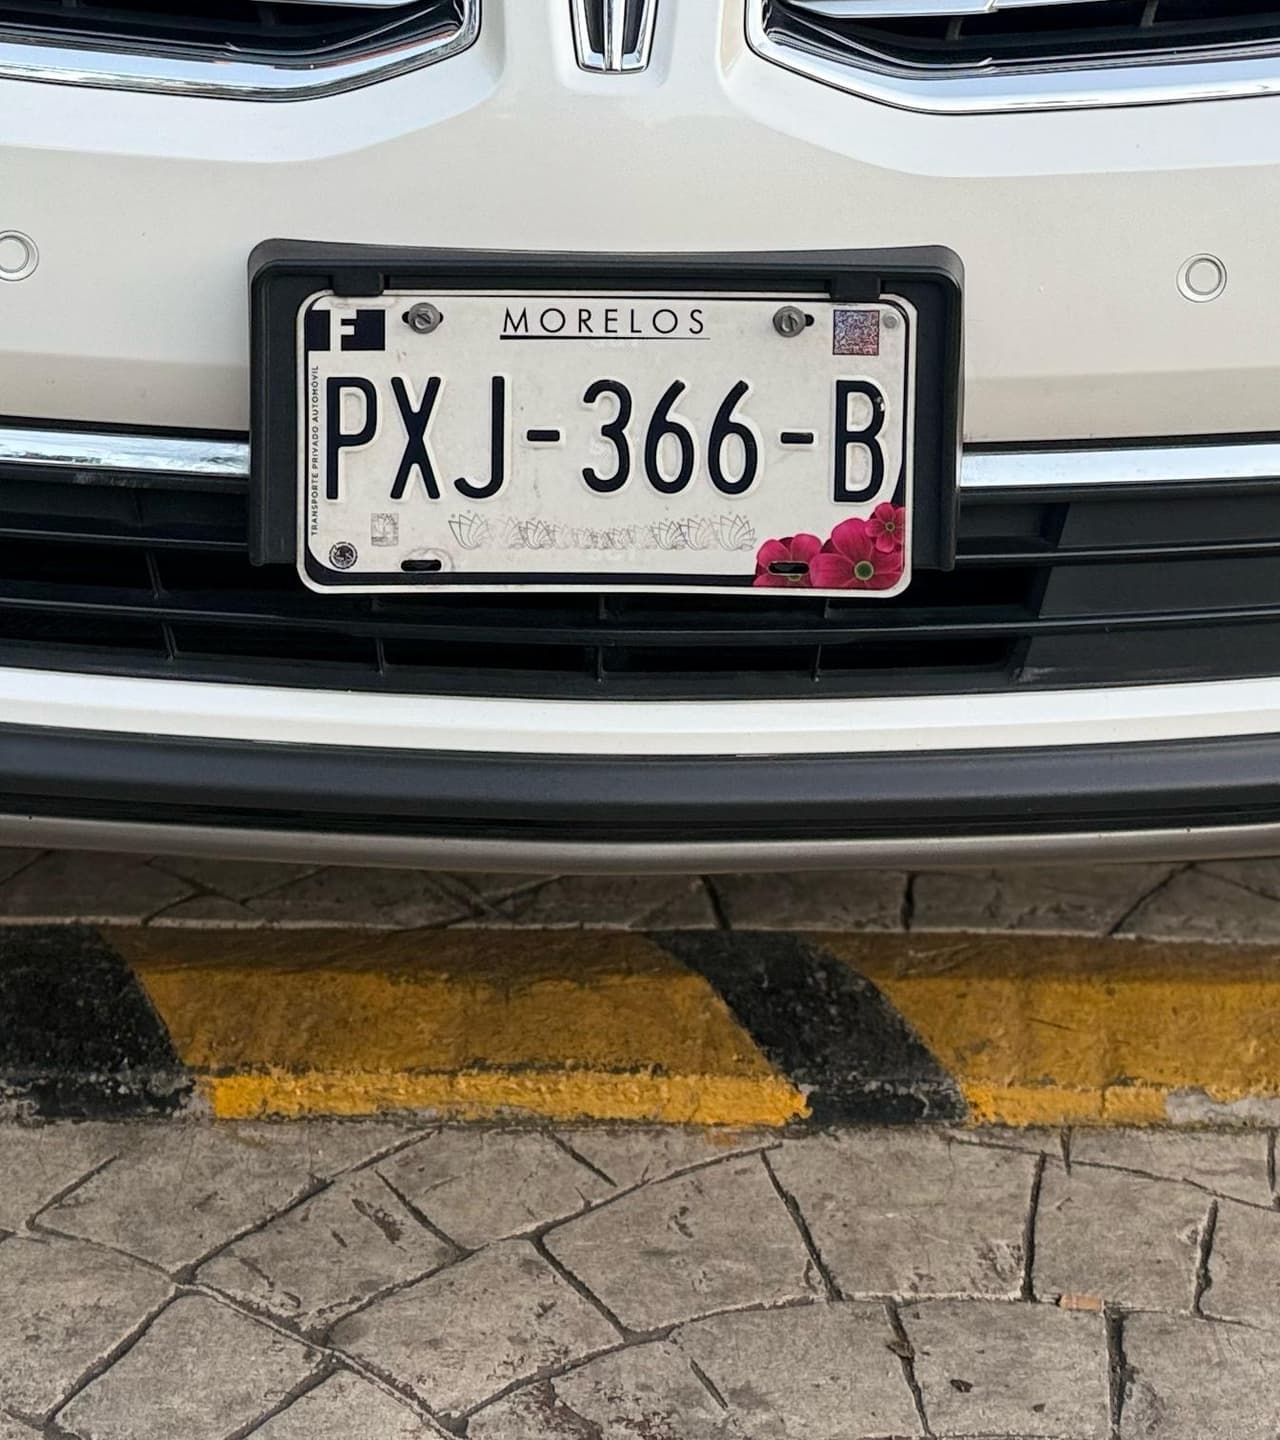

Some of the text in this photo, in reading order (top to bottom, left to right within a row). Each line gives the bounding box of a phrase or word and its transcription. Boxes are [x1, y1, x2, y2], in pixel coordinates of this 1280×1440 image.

[501, 306, 706, 336] MORELOS
[311, 425, 319, 464] PRIVADO
[324, 375, 887, 505] PXJ-366-B
[310, 466, 319, 537] TRANSPORTE
